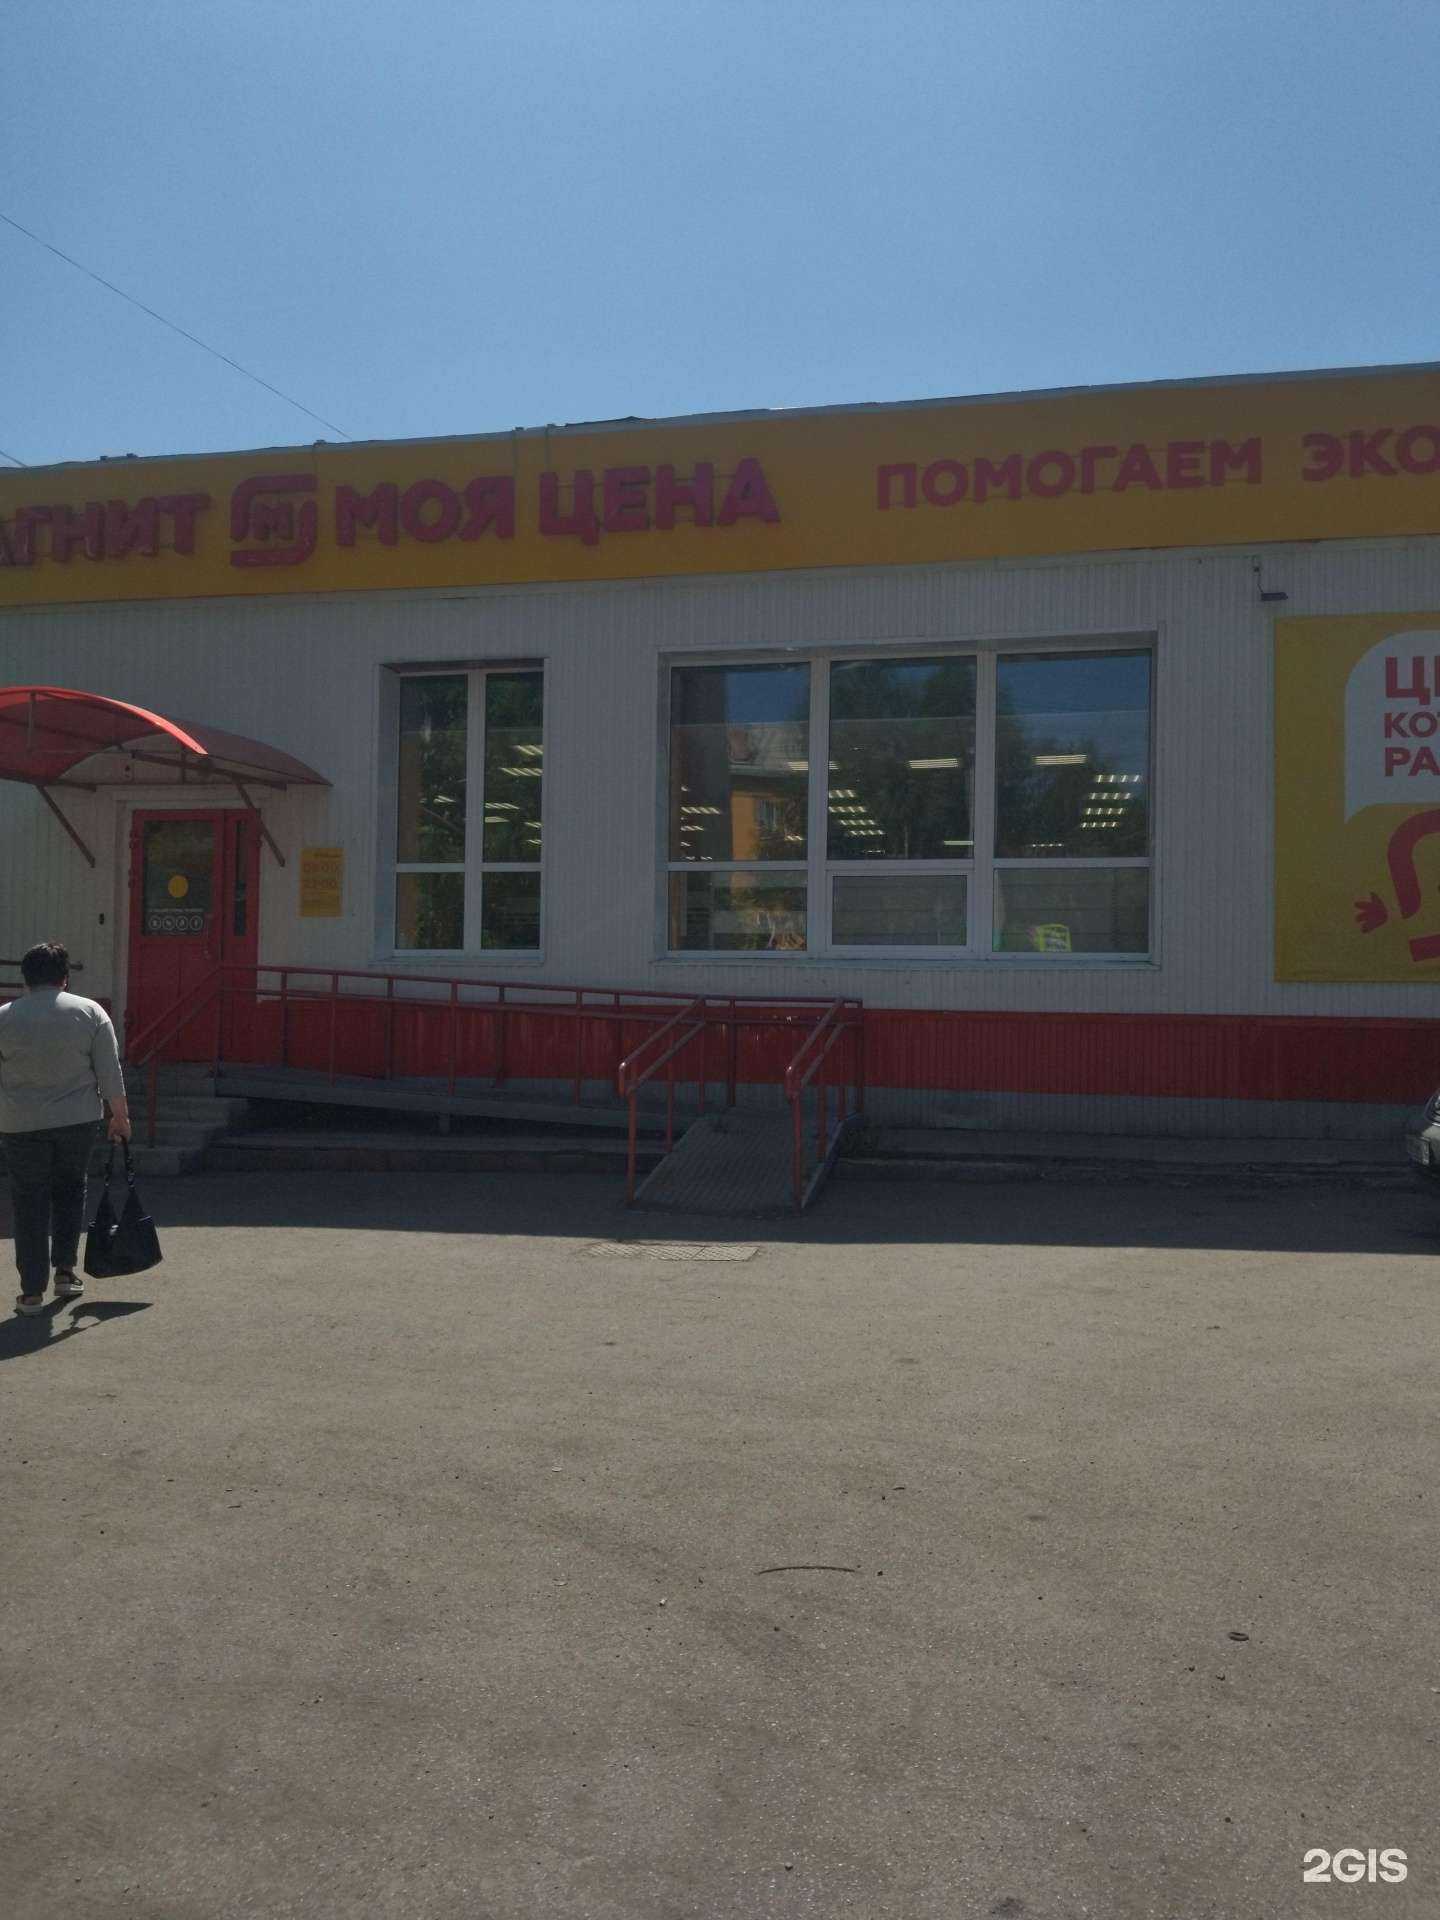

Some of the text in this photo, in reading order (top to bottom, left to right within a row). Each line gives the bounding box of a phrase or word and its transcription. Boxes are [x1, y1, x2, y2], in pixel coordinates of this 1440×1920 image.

[876, 425, 1440, 510] ПОМОГАЕМ ЭКО
[335, 476, 516, 547] МОЯ
[538, 457, 781, 546] ЦЕНА
[1385, 656, 1440, 705] Ц
[1384, 711, 1440, 738] КО
